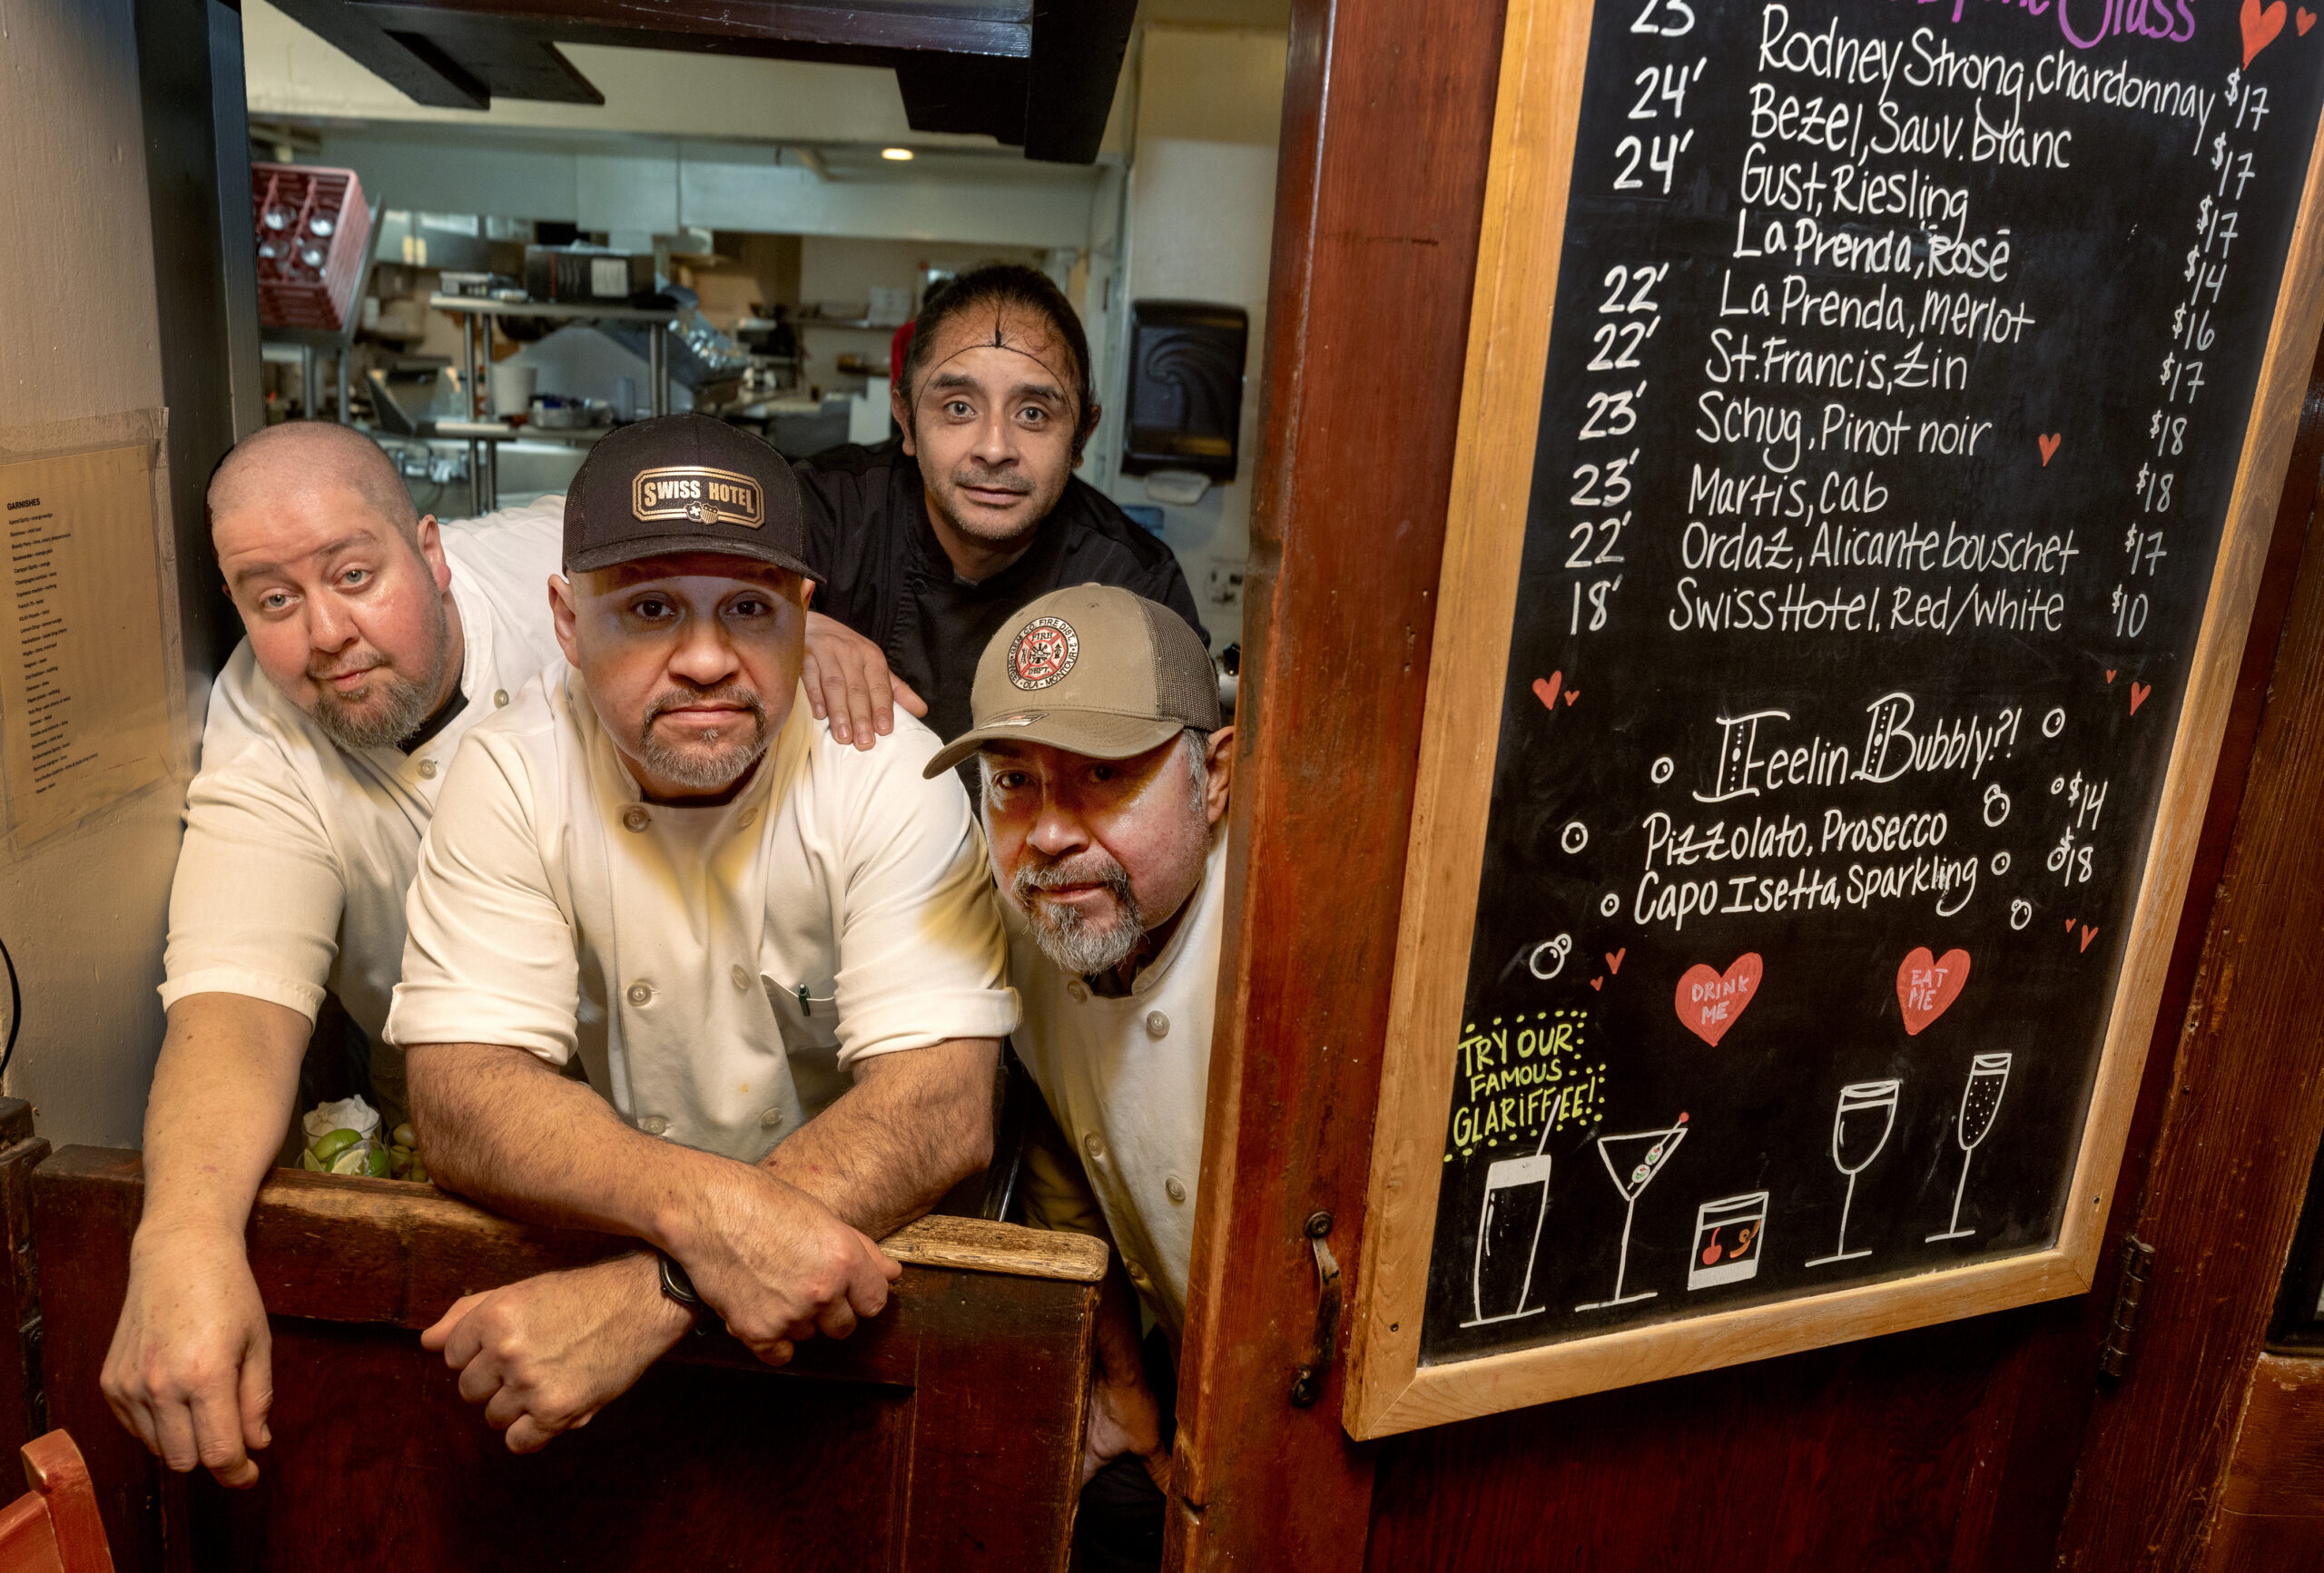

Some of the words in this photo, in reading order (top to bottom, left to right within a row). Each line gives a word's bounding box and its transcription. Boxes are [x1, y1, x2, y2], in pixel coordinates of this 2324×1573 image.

[1758, 4, 1903, 106] Rodney
[2225, 67, 2269, 132] $17
[2211, 132, 2255, 200] $17
[1832, 163, 1968, 249] Riesling
[2197, 194, 2238, 259] $17
[1733, 208, 1787, 258] La
[2184, 244, 2227, 306] $14
[1720, 270, 1769, 317] La
[2172, 300, 2215, 351] $16
[2161, 351, 2205, 404] $17
[1820, 403, 1911, 457] Pinot
[1918, 411, 1993, 457] noir
[2150, 409, 2188, 457] $18
[7, 497, 41, 511] GARNISHES
[644, 479, 701, 507] SWISS
[708, 482, 755, 515] HOTEL
[2136, 461, 2174, 514] $18
[1808, 519, 1940, 574] Alicante
[2125, 523, 2168, 577] $17
[1010, 634, 1025, 654] GEM
[1039, 618, 1060, 627] FIRE
[2112, 584, 2150, 638] $10
[1009, 658, 1021, 684] SWEET
[1023, 681, 1039, 689] OLA
[1045, 652, 1078, 687] MONTOUR
[1820, 808, 1949, 856] Prosecco
[2068, 770, 2108, 832] $14
[1633, 870, 1718, 932] Capo
[1846, 855, 1978, 919] Sparkling
[1690, 975, 1749, 1007] DRINK
[1907, 986, 1935, 1011] ME
[1910, 967, 1948, 990] EAT
[1700, 1001, 1729, 1027] ME
[1458, 1034, 1512, 1077] TRY
[1517, 1022, 1574, 1059] OUR
[1470, 1059, 1563, 1104] FAMOUS
